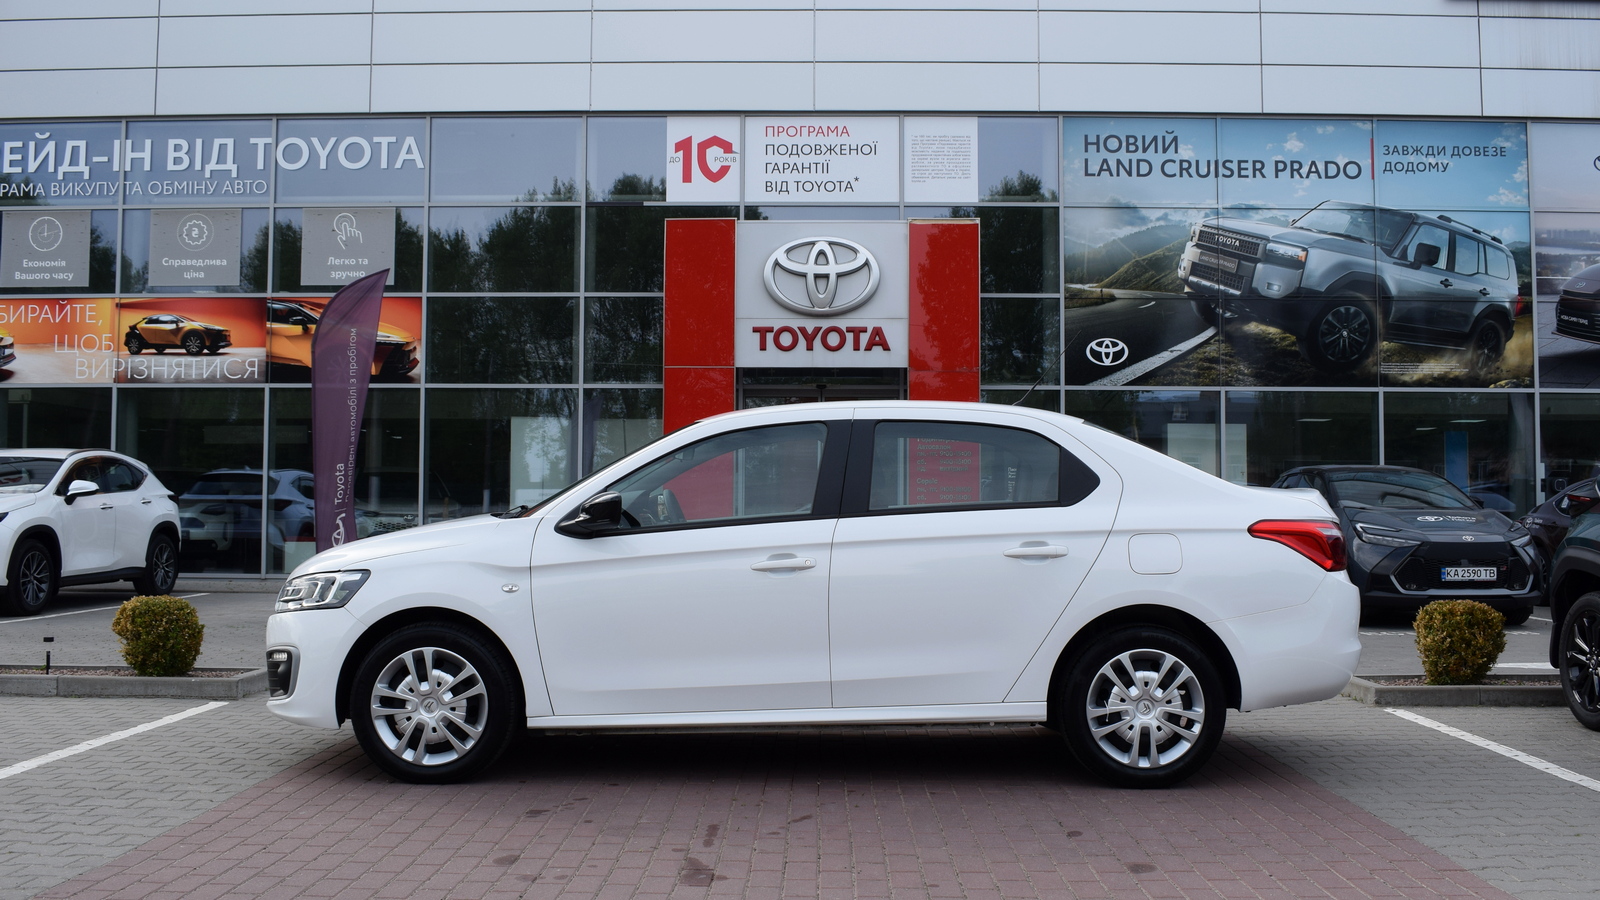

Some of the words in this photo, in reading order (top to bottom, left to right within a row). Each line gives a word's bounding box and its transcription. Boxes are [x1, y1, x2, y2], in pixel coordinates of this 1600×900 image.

[765, 125, 850, 137] ПРОГРАМА
[1084, 130, 1178, 154] НОВИЙ
[765, 141, 878, 158] ПОДОВЖЕНОЇ
[1383, 145, 1446, 158] ЗАВЖДИ
[1451, 146, 1507, 159] ДОВЕЗЕ
[167, 138, 238, 178] ВІД
[250, 136, 425, 171] TOYOTA
[669, 156, 681, 164] ДО
[765, 159, 831, 174] ГАРАНТІЇ
[1084, 158, 1153, 177] LAND
[1160, 158, 1266, 179] CRUISER
[1274, 160, 1362, 180] PRADO
[1383, 162, 1449, 174] ДОДОМУ
[0, 183, 45, 197] РАМА
[51, 181, 119, 196] ВИКУПУ
[124, 181, 143, 195] ТА
[148, 180, 217, 195] ОБМІНУ
[222, 180, 267, 194] АВТО
[765, 180, 790, 195] ВІД
[1214, 235, 1240, 246] TOYOTA
[23, 258, 66, 267] Економія
[162, 257, 227, 267] Справедлива
[327, 256, 356, 265] Легко
[15, 271, 50, 280] Вашого
[52, 272, 74, 281] часу
[183, 269, 205, 279] ціна
[330, 271, 366, 279] зручно
[54, 334, 114, 356] ЩОБ
[752, 325, 891, 351] TOYOTA
[347, 328, 359, 376] пробігом
[75, 358, 259, 379] ВИРІЗНЯТИСЯ
[335, 463, 345, 505] Toyota
[1446, 569, 1460, 578] KA
[1461, 569, 1482, 578] 2590
[1483, 569, 1496, 578] TB
